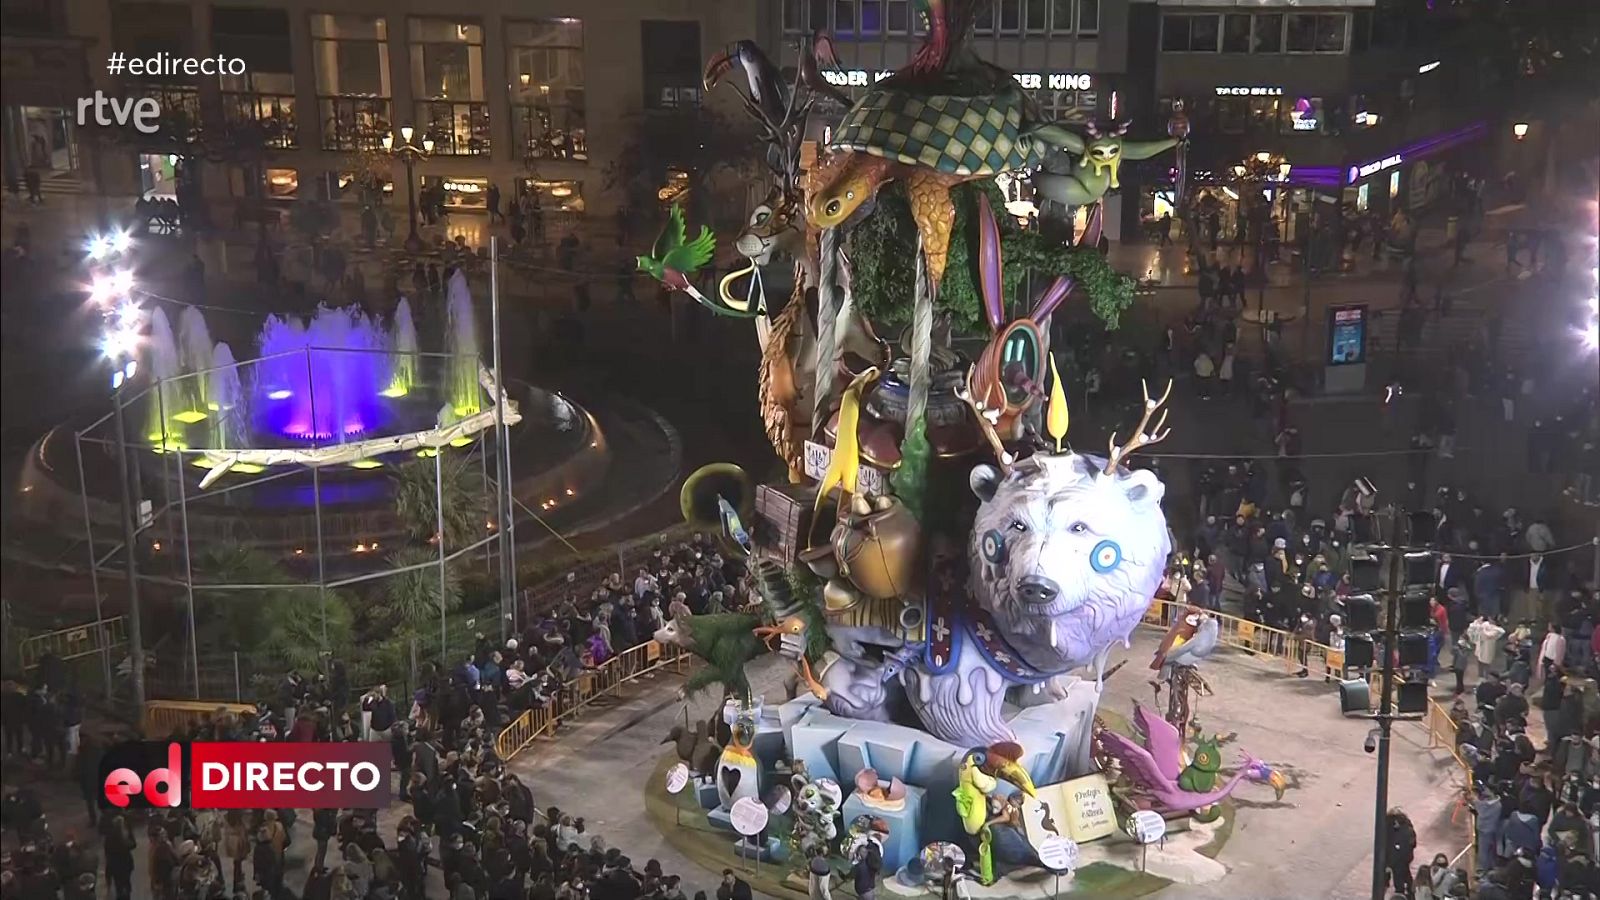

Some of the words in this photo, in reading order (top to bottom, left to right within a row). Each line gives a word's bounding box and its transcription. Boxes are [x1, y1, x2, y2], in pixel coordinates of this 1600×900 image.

[1048, 74, 1091, 90] KING
[1216, 87, 1249, 95] TACO
[1250, 87, 1283, 95] BELL
